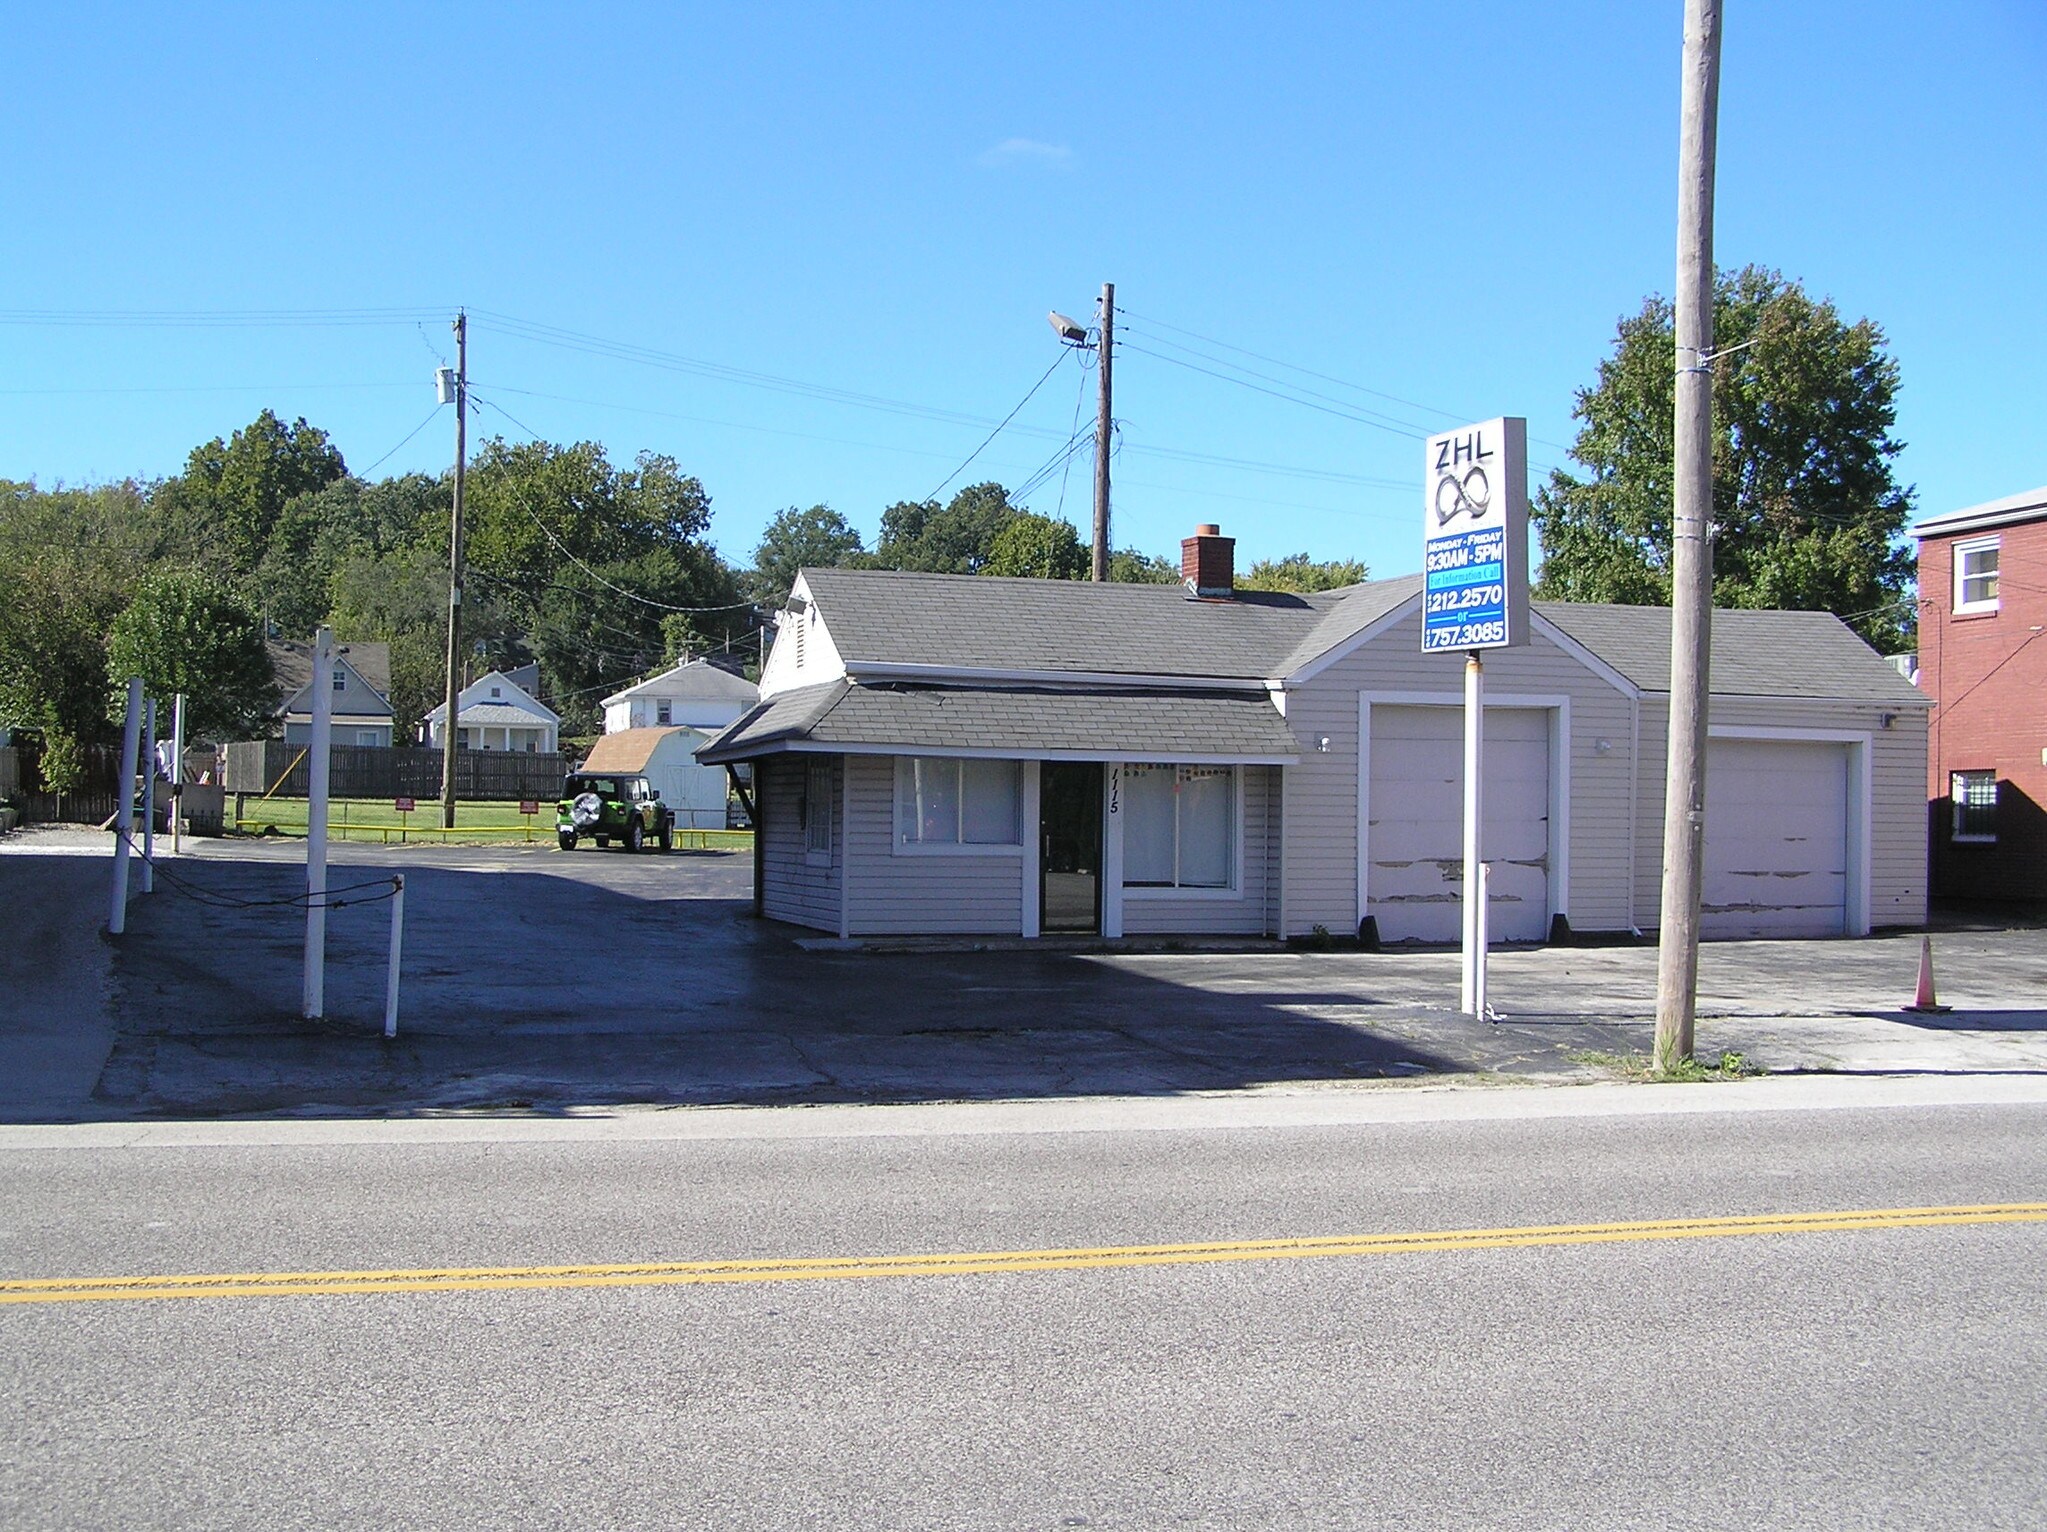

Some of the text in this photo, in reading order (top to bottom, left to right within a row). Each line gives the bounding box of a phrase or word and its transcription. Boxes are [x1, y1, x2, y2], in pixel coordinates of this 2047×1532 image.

[1435, 430, 1493, 469] ZHL
[1428, 538, 1463, 553] MONDAY
[1467, 531, 1502, 546] FRIDAY
[1474, 541, 1503, 564] 5PM
[1430, 566, 1499, 587] For Information Call
[1457, 612, 1468, 622] or
[1110, 768, 1118, 813] 1115
